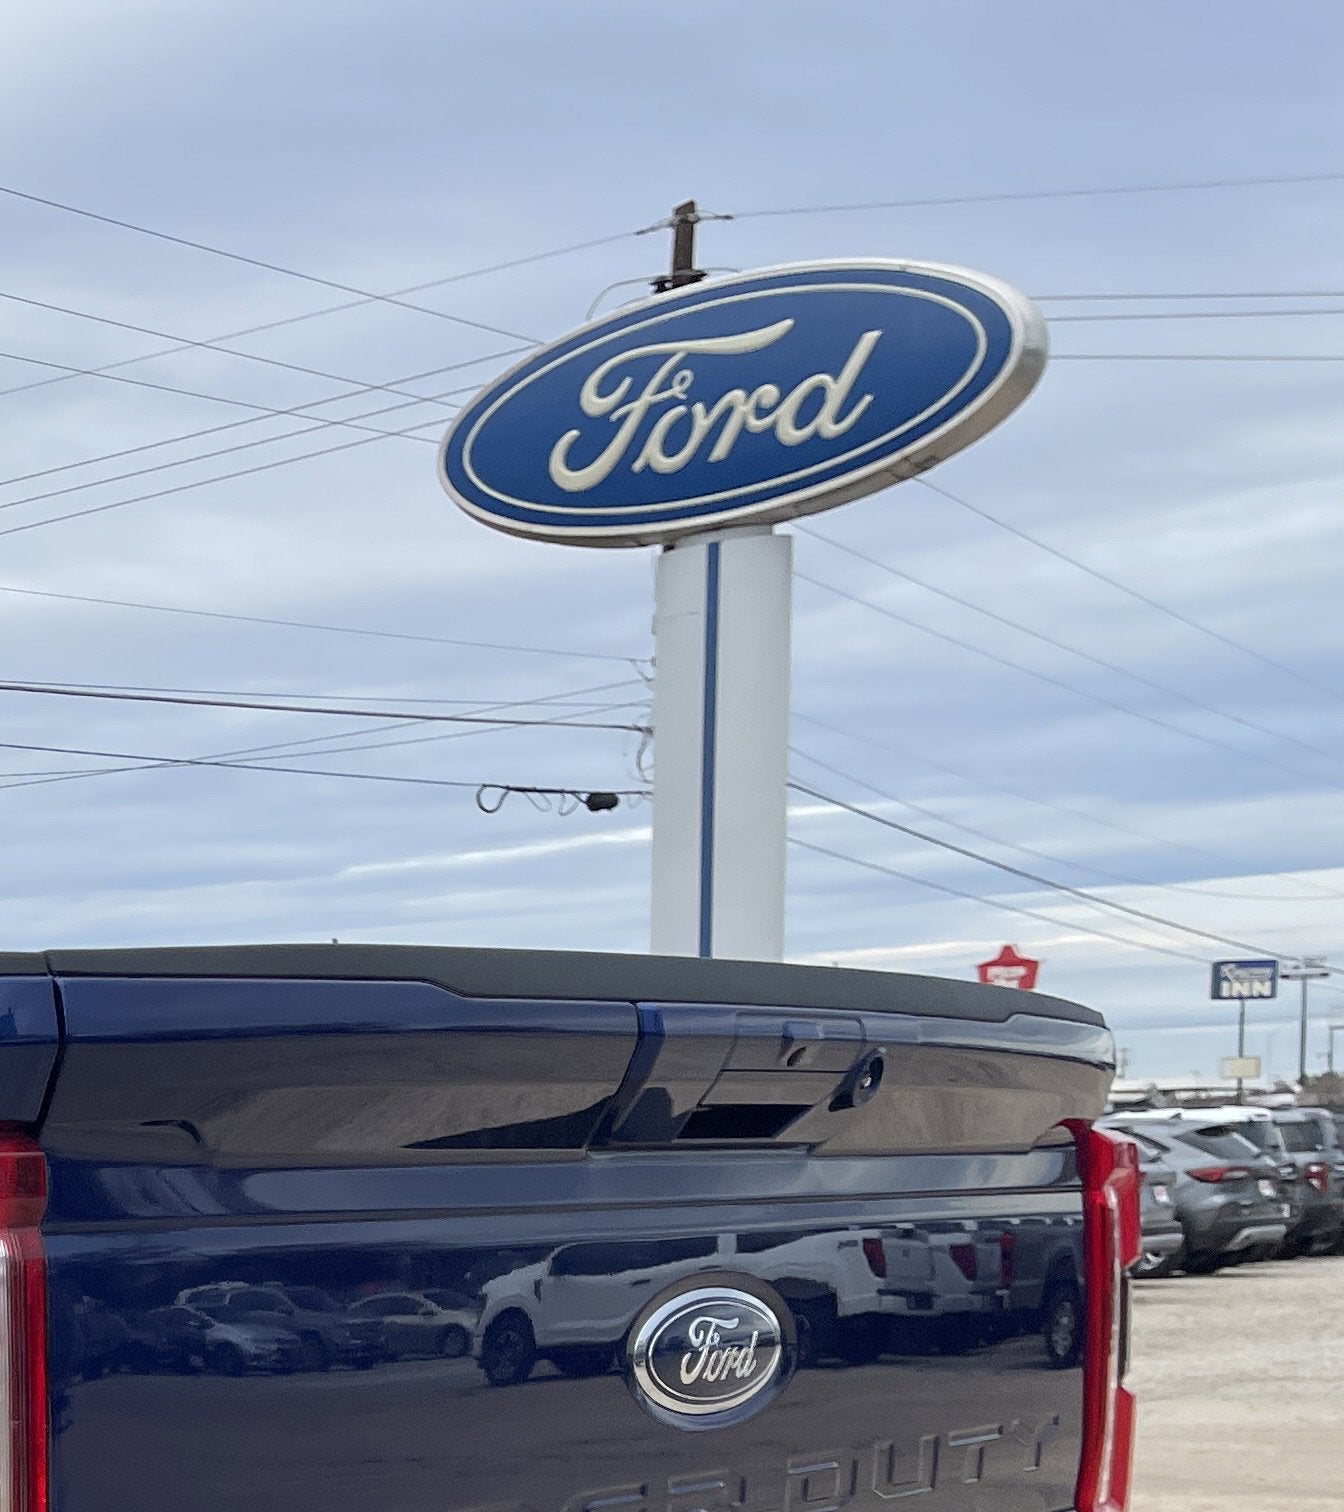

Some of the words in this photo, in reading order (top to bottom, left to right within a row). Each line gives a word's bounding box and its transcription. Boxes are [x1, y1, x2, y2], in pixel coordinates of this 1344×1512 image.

[548, 318, 883, 492] Ford
[1220, 980, 1272, 997] INN
[680, 1315, 760, 1385] Ford
